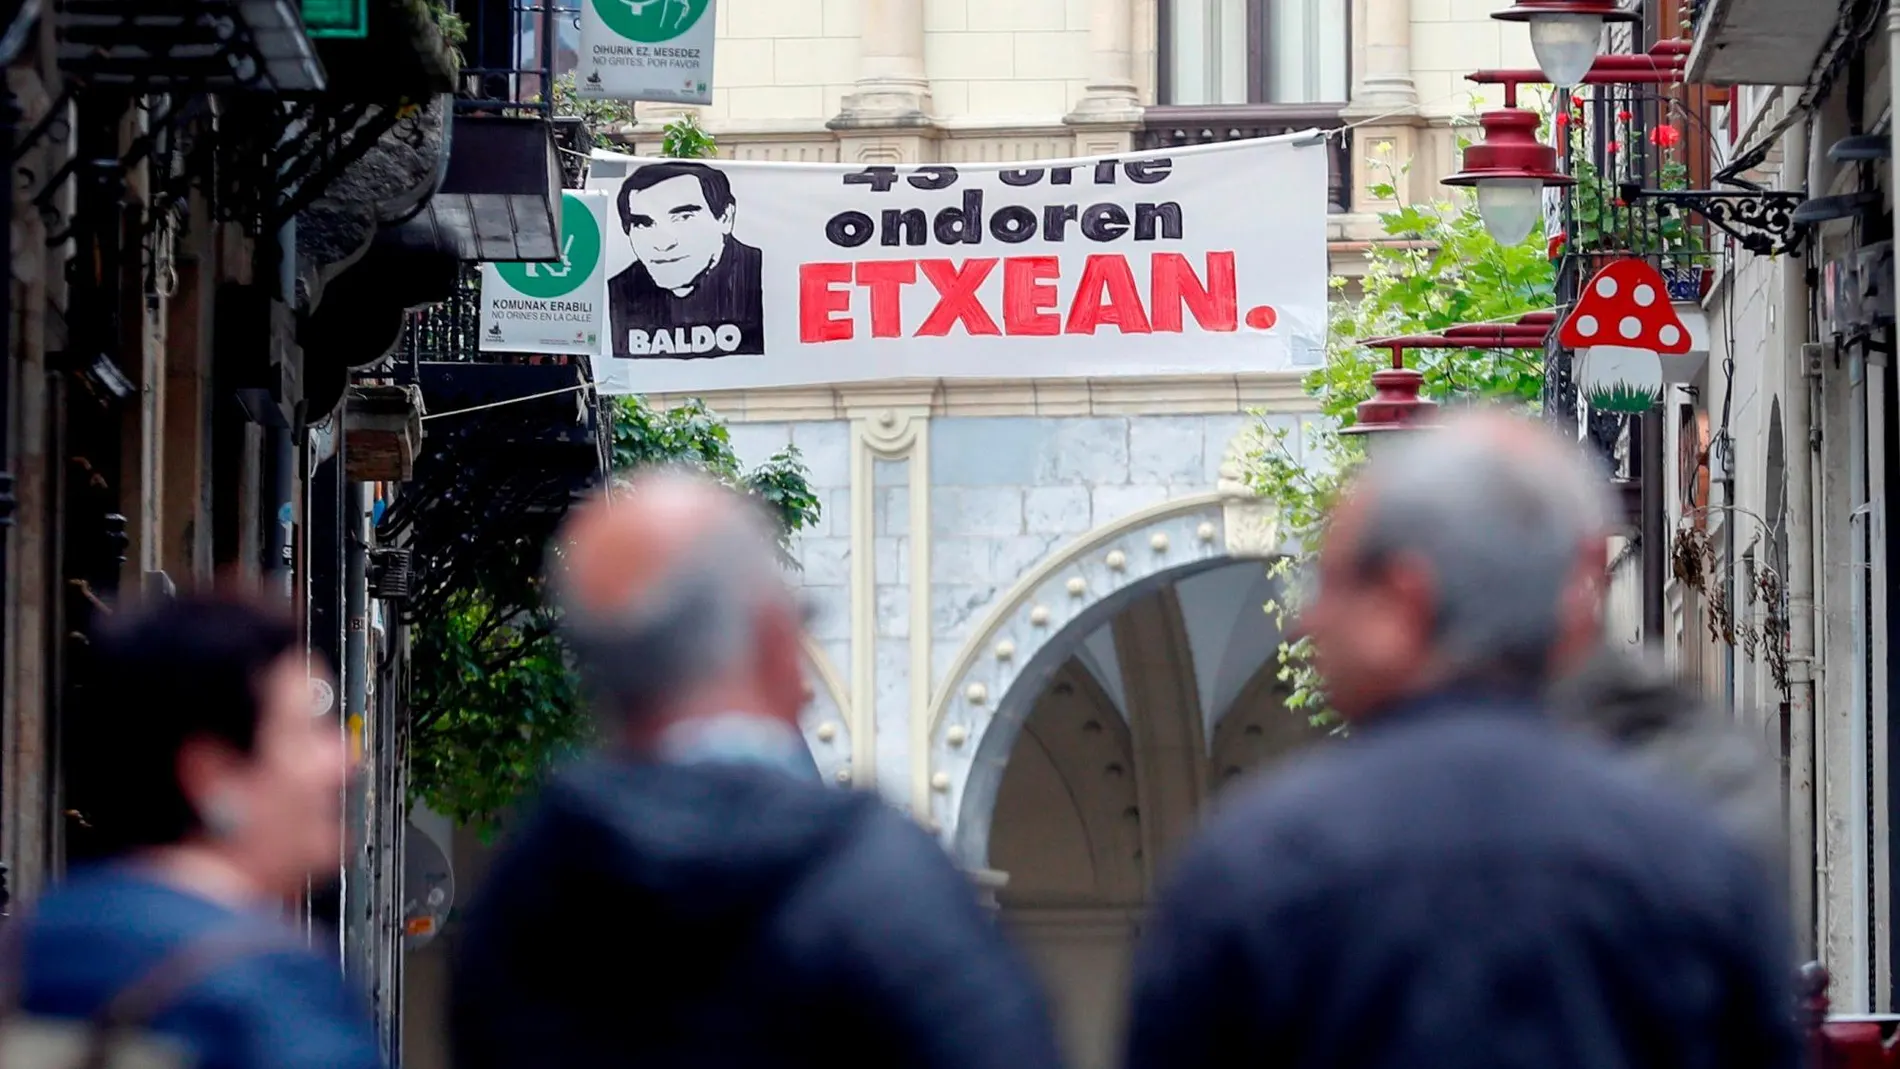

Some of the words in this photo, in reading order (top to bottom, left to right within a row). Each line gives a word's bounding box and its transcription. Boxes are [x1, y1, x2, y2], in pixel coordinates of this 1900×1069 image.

[593, 45, 634, 56] OIHURIK
[654, 47, 700, 58] MESEDEZ
[592, 56, 606, 66] NO
[647, 57, 668, 68] POR
[669, 59, 699, 69] FAVOR
[825, 189, 1183, 248] ondoren
[798, 250, 1278, 343] ETXEAN.
[493, 300, 548, 310] KOMUNAK
[551, 302, 592, 312] ERABILI
[492, 311, 504, 320] NO
[506, 311, 538, 321] ORINES
[540, 312, 552, 322] EN
[553, 313, 565, 322] LA
[565, 313, 592, 323] CALLE
[628, 323, 742, 355] BALDO
